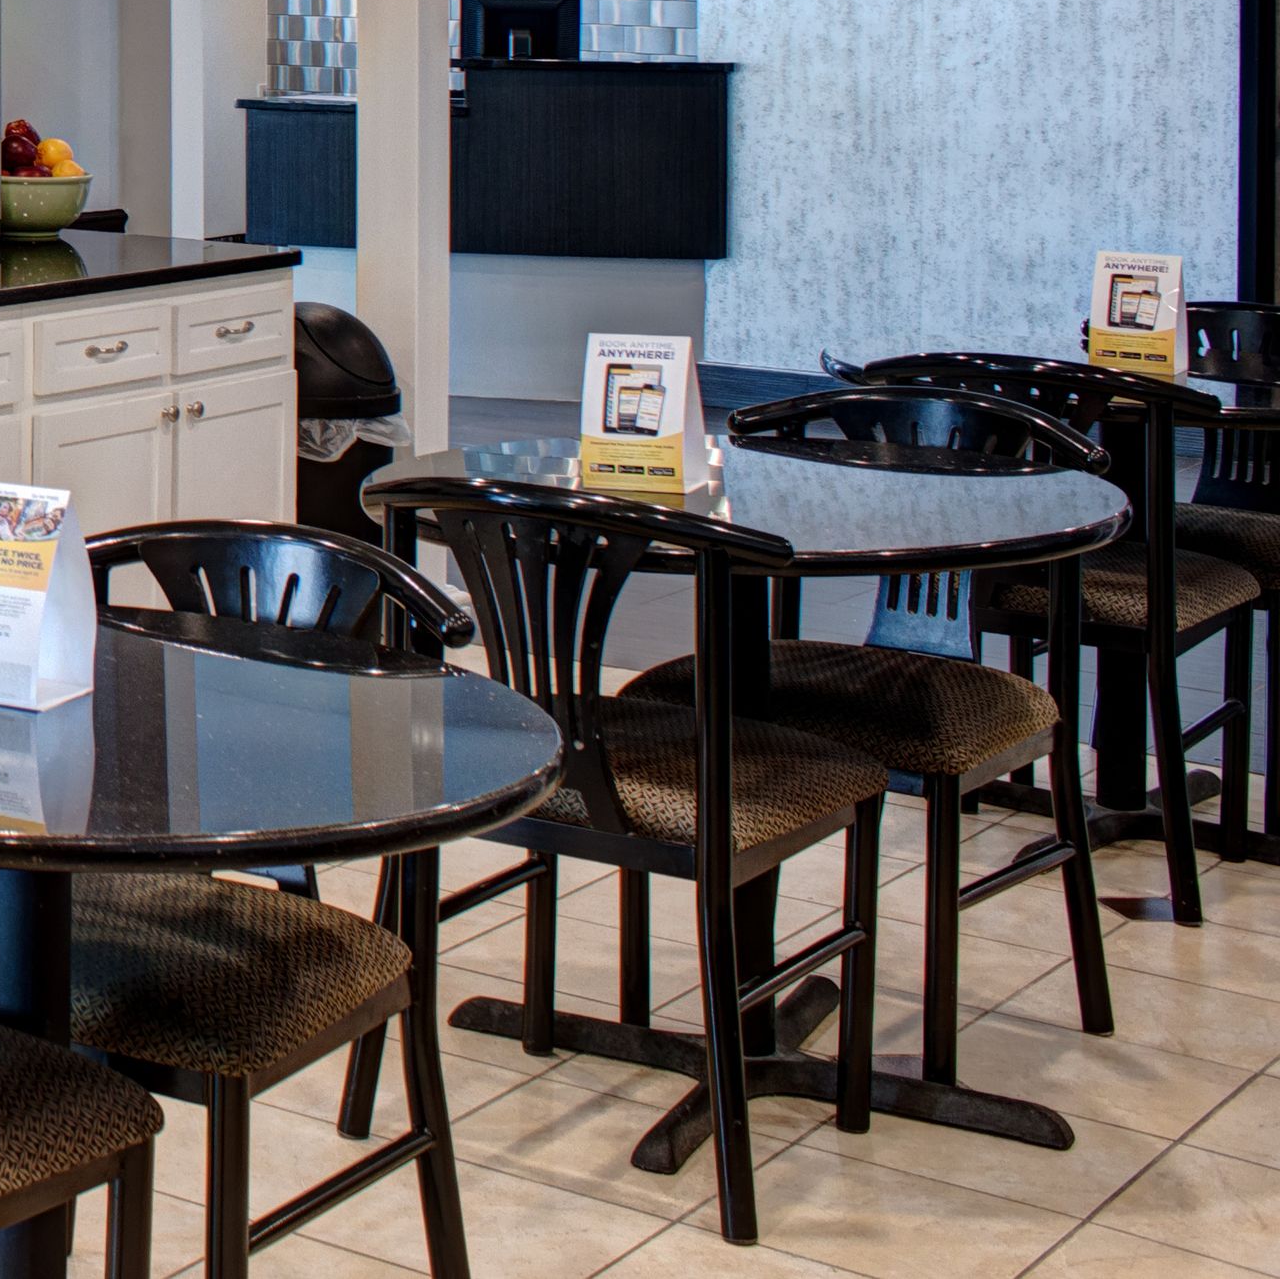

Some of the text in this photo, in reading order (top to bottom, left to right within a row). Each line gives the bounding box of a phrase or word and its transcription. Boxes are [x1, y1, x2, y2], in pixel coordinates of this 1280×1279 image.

[1104, 262, 1169, 273] ANYWHERE!
[599, 340, 627, 348] BOOK
[597, 349, 676, 360] ANYWHERE!
[11, 549, 42, 561] TWICE.
[0, 557, 15, 567] NO
[16, 559, 44, 572] PRICE.
